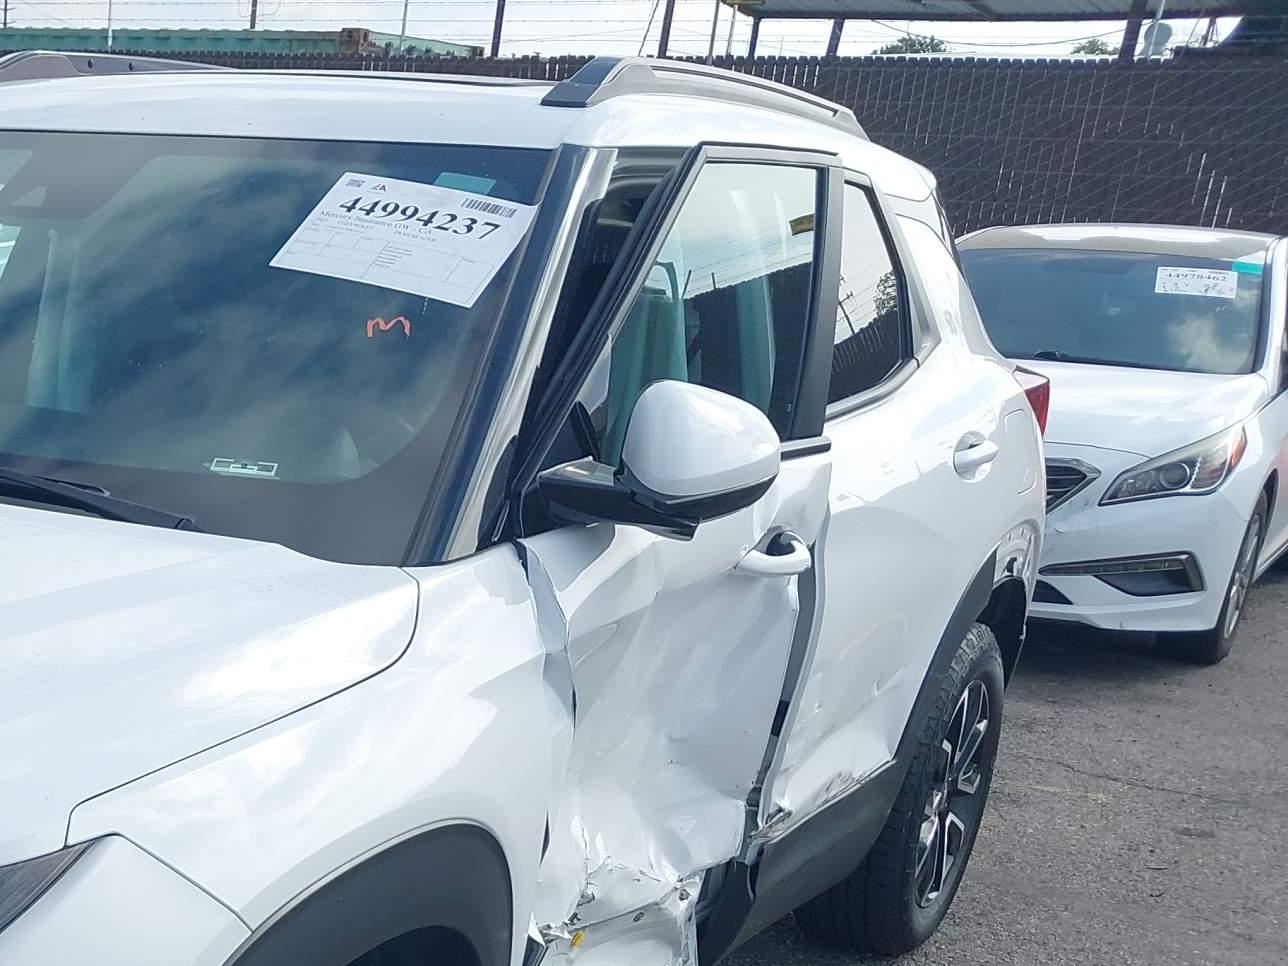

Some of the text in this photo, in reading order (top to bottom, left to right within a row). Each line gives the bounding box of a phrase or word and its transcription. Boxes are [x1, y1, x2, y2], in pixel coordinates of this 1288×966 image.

[319, 210, 353, 222] Mercury
[354, 215, 394, 228] Insurance
[418, 226, 433, 236] CA
[339, 196, 501, 240] 44994237
